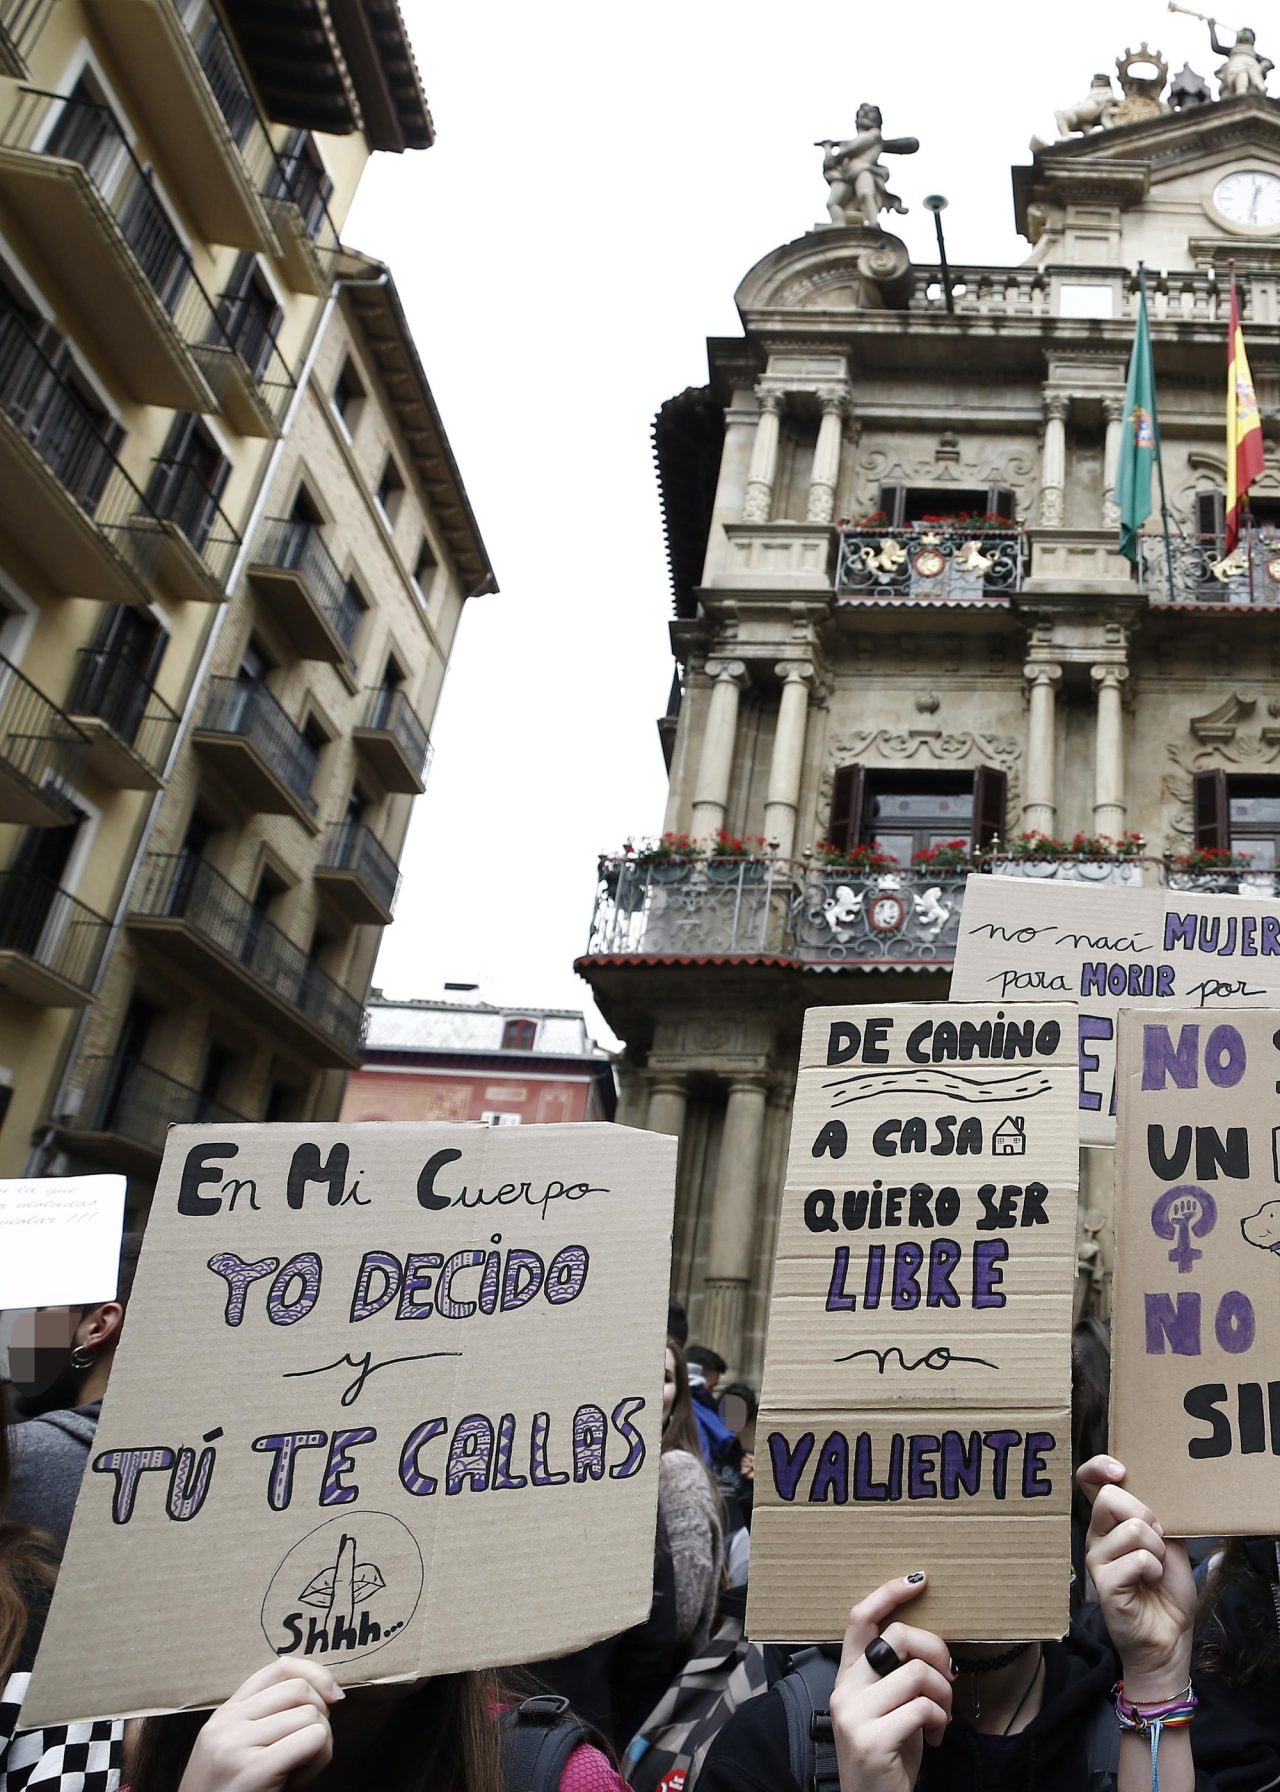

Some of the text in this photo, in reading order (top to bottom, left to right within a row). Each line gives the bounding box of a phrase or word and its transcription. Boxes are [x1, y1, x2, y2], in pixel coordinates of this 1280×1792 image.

[969, 923, 1058, 943] no
[986, 962, 1267, 1006] para MORIR por
[827, 1018, 894, 1066] DE
[1142, 1023, 1247, 1092] NO
[811, 1115, 984, 1159] A CASA
[1147, 1123, 1249, 1181] UN
[176, 1142, 610, 1219] En Mi Cuerpo
[976, 1182, 1050, 1231] SER
[207, 1252, 322, 1326] YO
[825, 1238, 1009, 1312] LIBRE
[1145, 1290, 1255, 1356] NO
[283, 1350, 463, 1405] y
[834, 1347, 999, 1375] no
[92, 1397, 647, 1524] TÚ TE CALLAS
[768, 1429, 1056, 1505] VALIENTE
[278, 1612, 404, 1656] Shhh...
